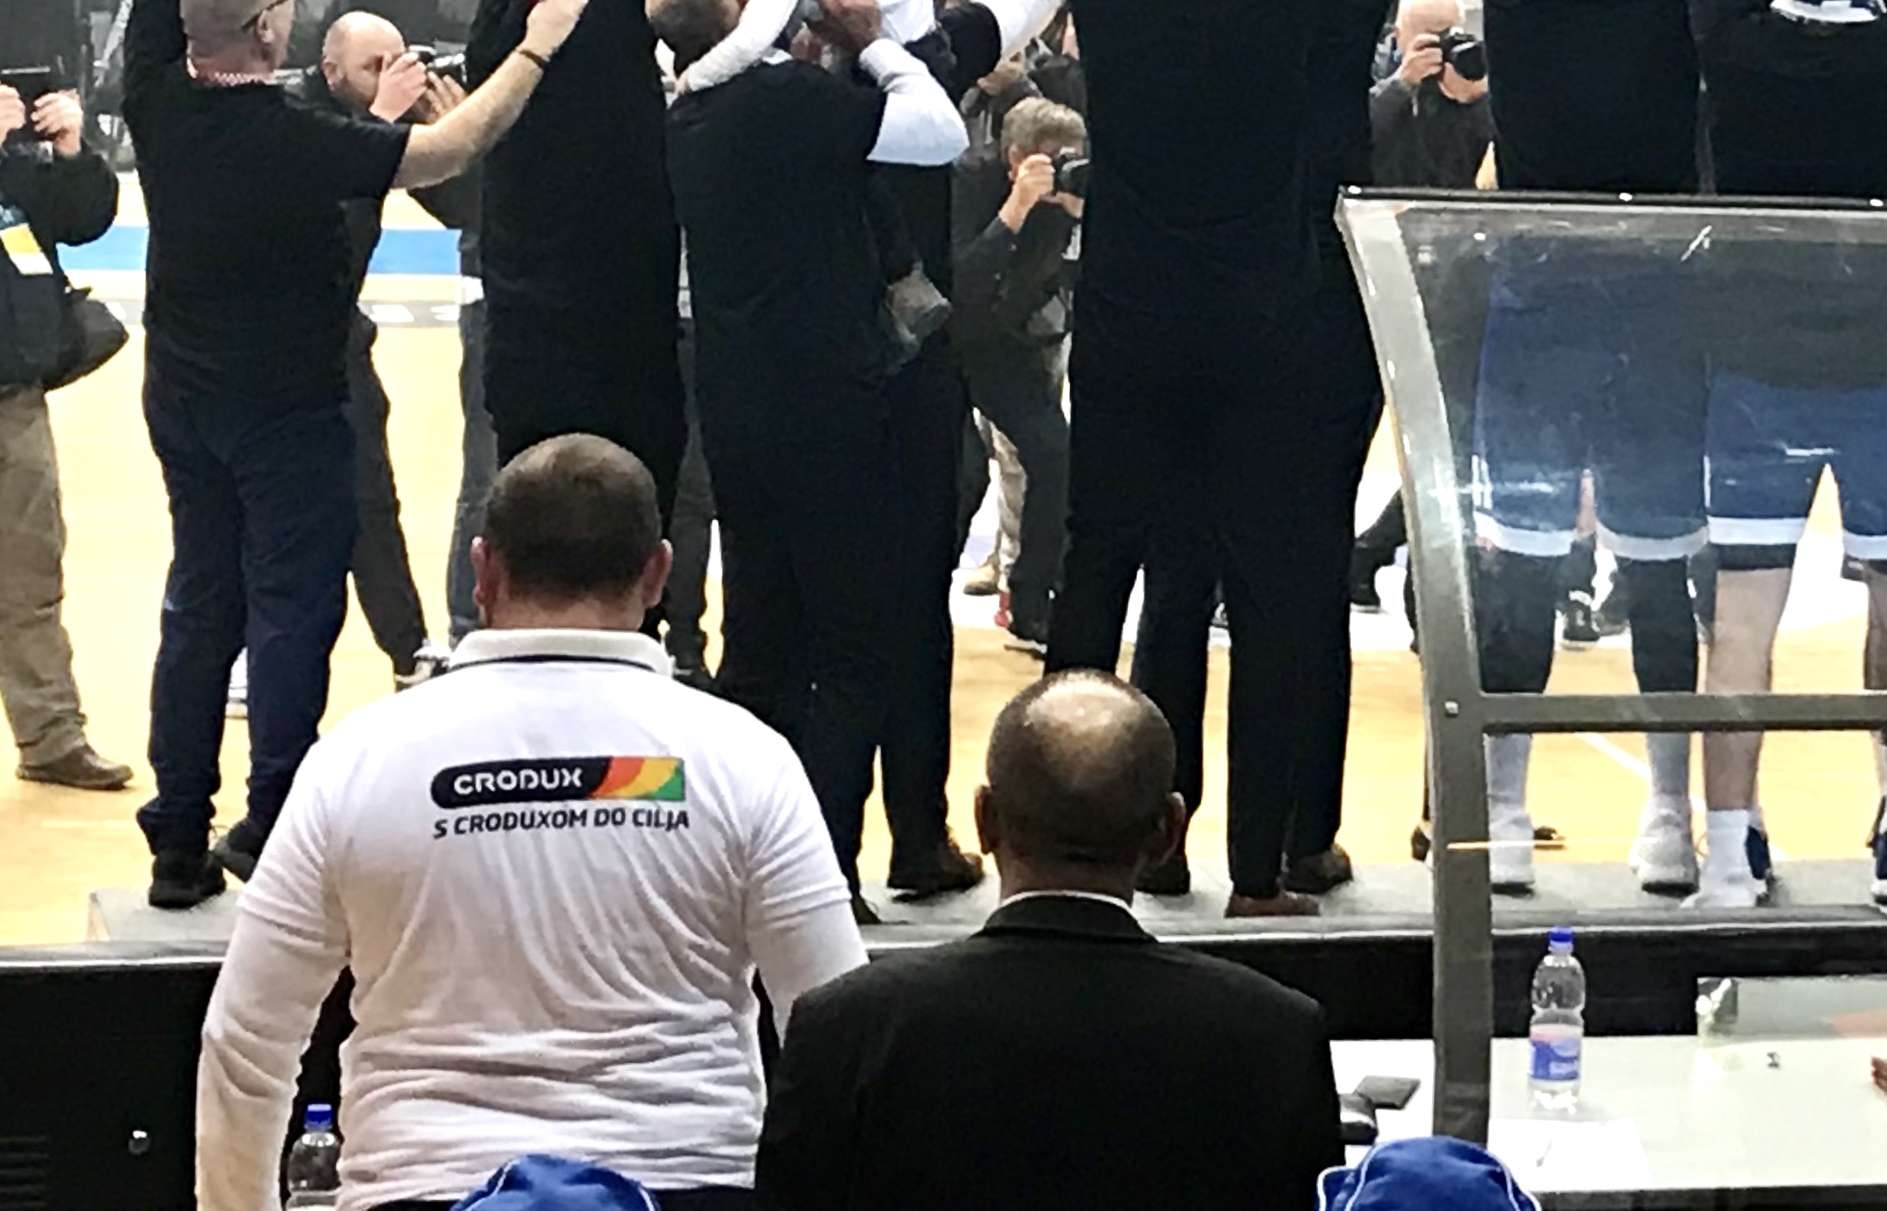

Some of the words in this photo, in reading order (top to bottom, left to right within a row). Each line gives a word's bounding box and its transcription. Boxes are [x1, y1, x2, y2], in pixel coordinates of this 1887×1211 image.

[453, 767, 583, 795] CRODUX
[432, 818, 449, 839] S
[453, 808, 588, 835] CRODUXOM
[593, 807, 626, 828] DO
[631, 807, 690, 833] CILJA
